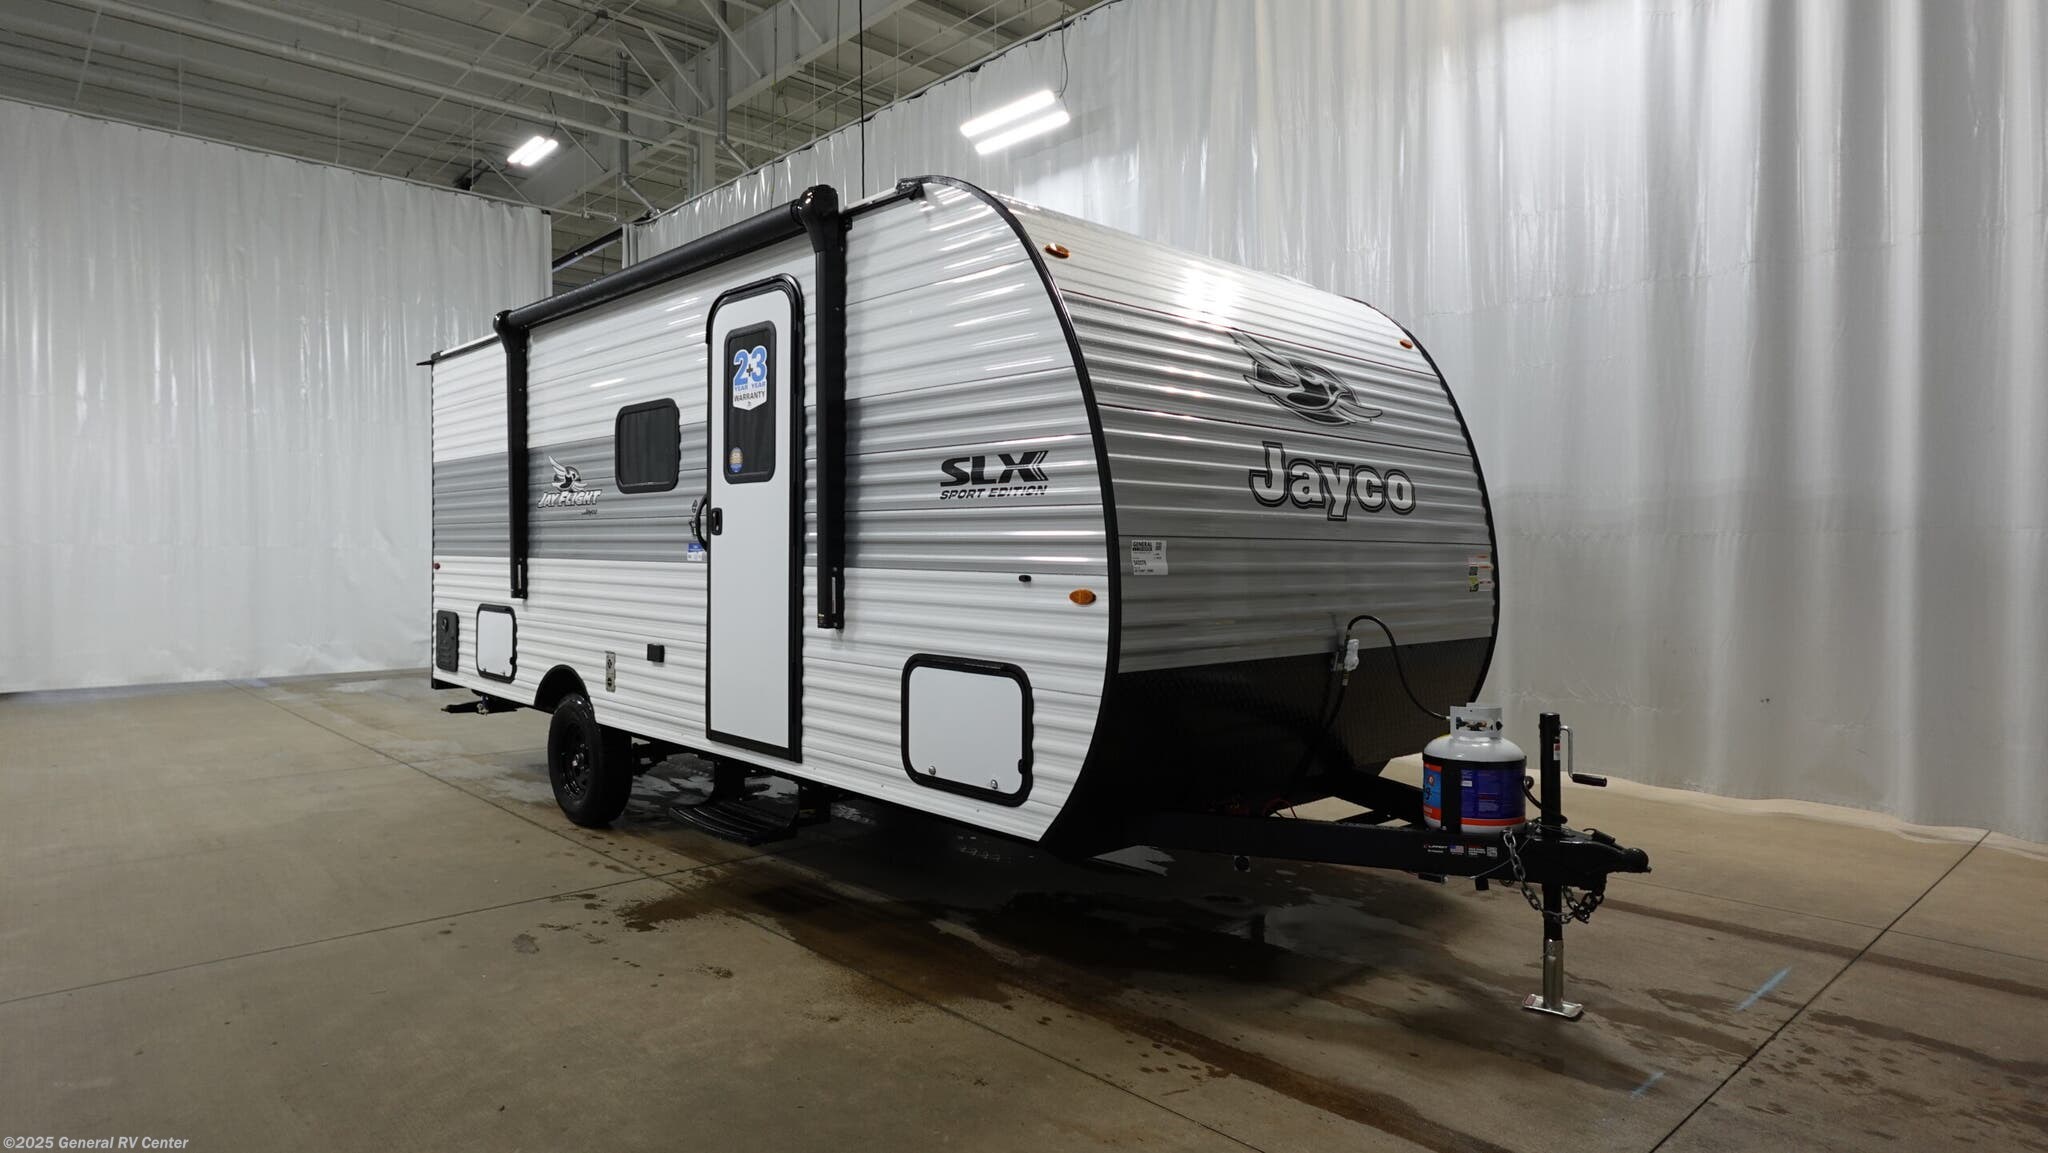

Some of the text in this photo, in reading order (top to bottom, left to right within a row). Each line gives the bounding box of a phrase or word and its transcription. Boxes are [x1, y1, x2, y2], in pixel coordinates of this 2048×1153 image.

[734, 391, 766, 402] WARRANTY
[940, 450, 1049, 487] SLX
[1249, 441, 1416, 521] Jayco
[537, 489, 602, 508] JAY FLIGHT
[940, 485, 1048, 500] SPORT EDITION
